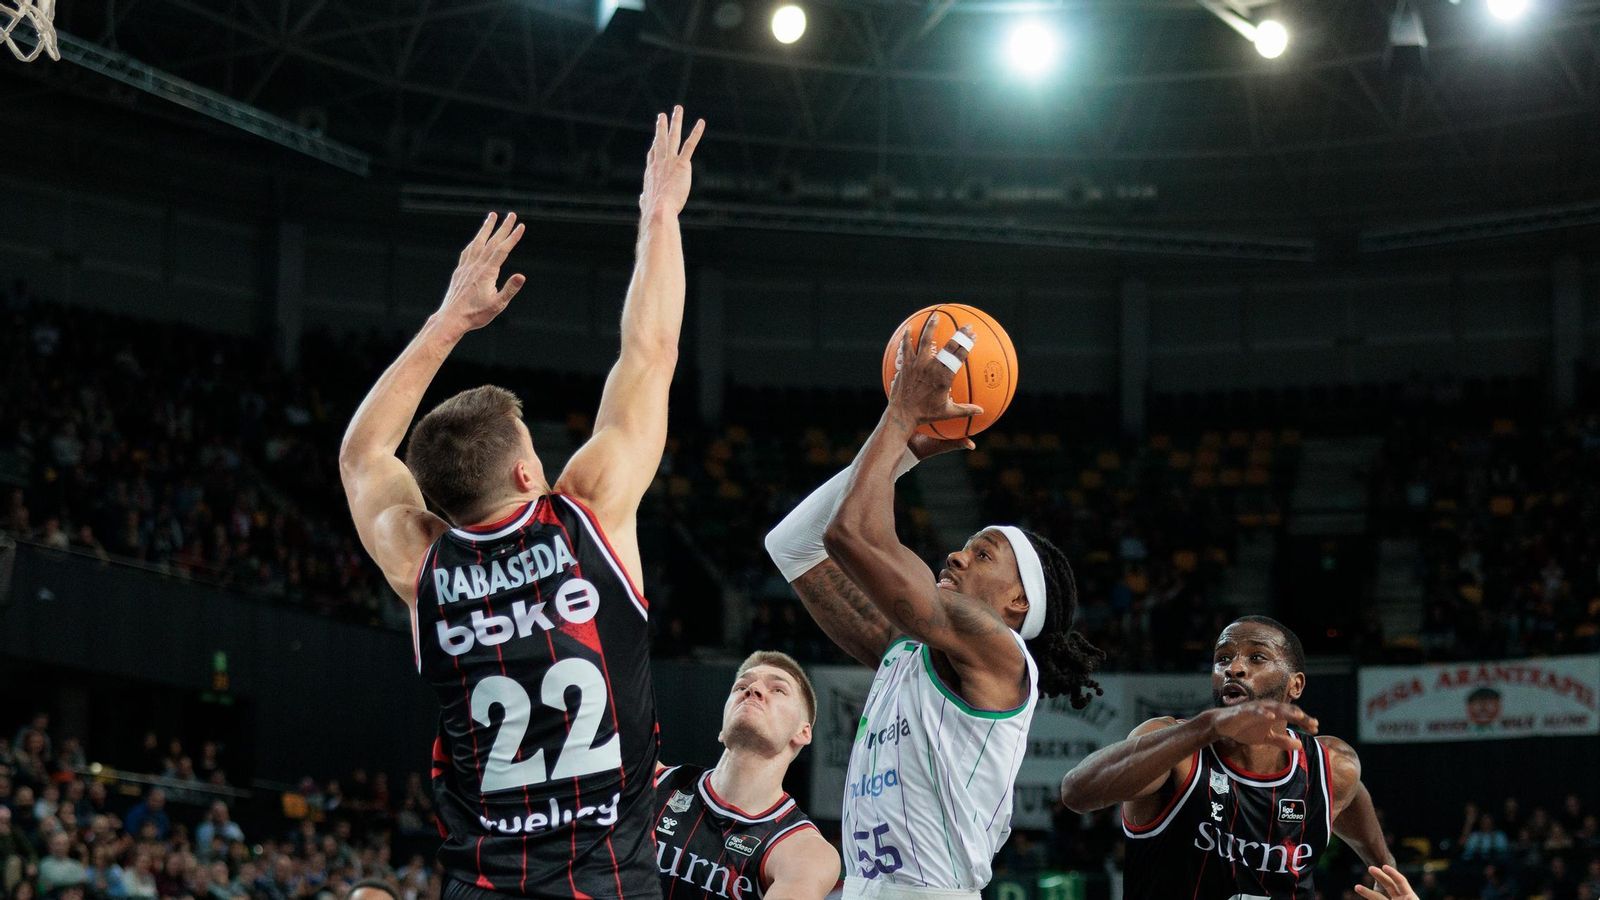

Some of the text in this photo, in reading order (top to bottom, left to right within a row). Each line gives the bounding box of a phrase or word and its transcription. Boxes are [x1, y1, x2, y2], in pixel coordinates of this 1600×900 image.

[434, 534, 578, 605] RABASEDA
[435, 600, 555, 656] bbk
[471, 657, 622, 793] 22
[657, 841, 753, 900] urne
[853, 822, 903, 880] 55
